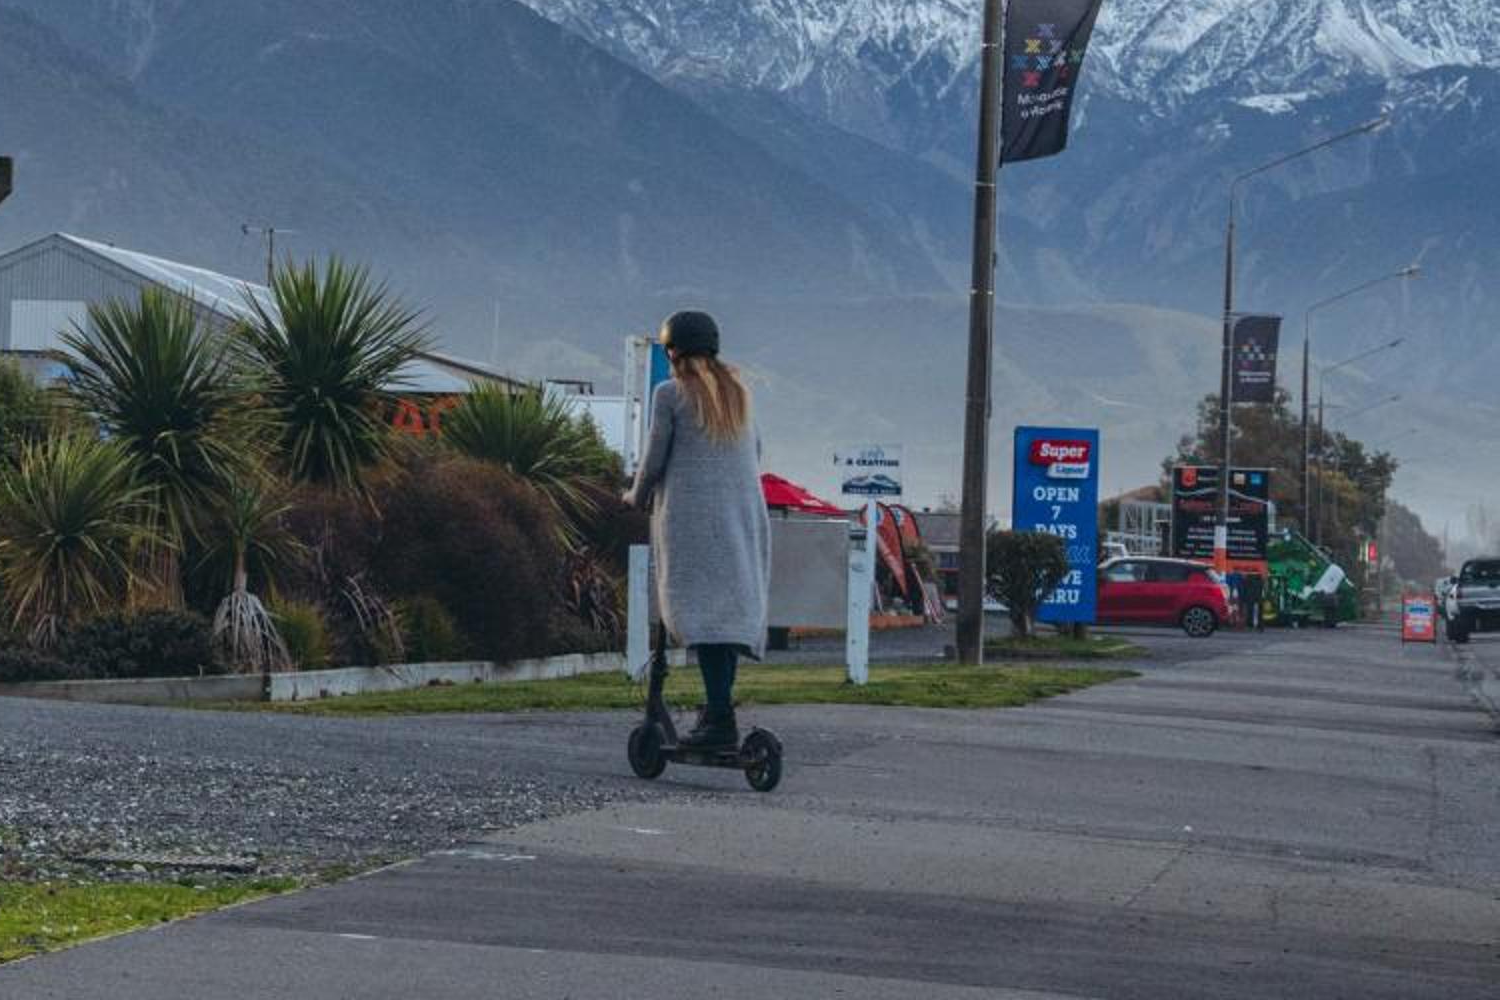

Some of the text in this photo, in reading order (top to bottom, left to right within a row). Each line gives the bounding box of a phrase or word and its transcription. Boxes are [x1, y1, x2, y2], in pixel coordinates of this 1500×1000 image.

[1039, 443, 1087, 460] Super
[1033, 487, 1080, 503] OPEN
[1051, 506, 1061, 521] 7
